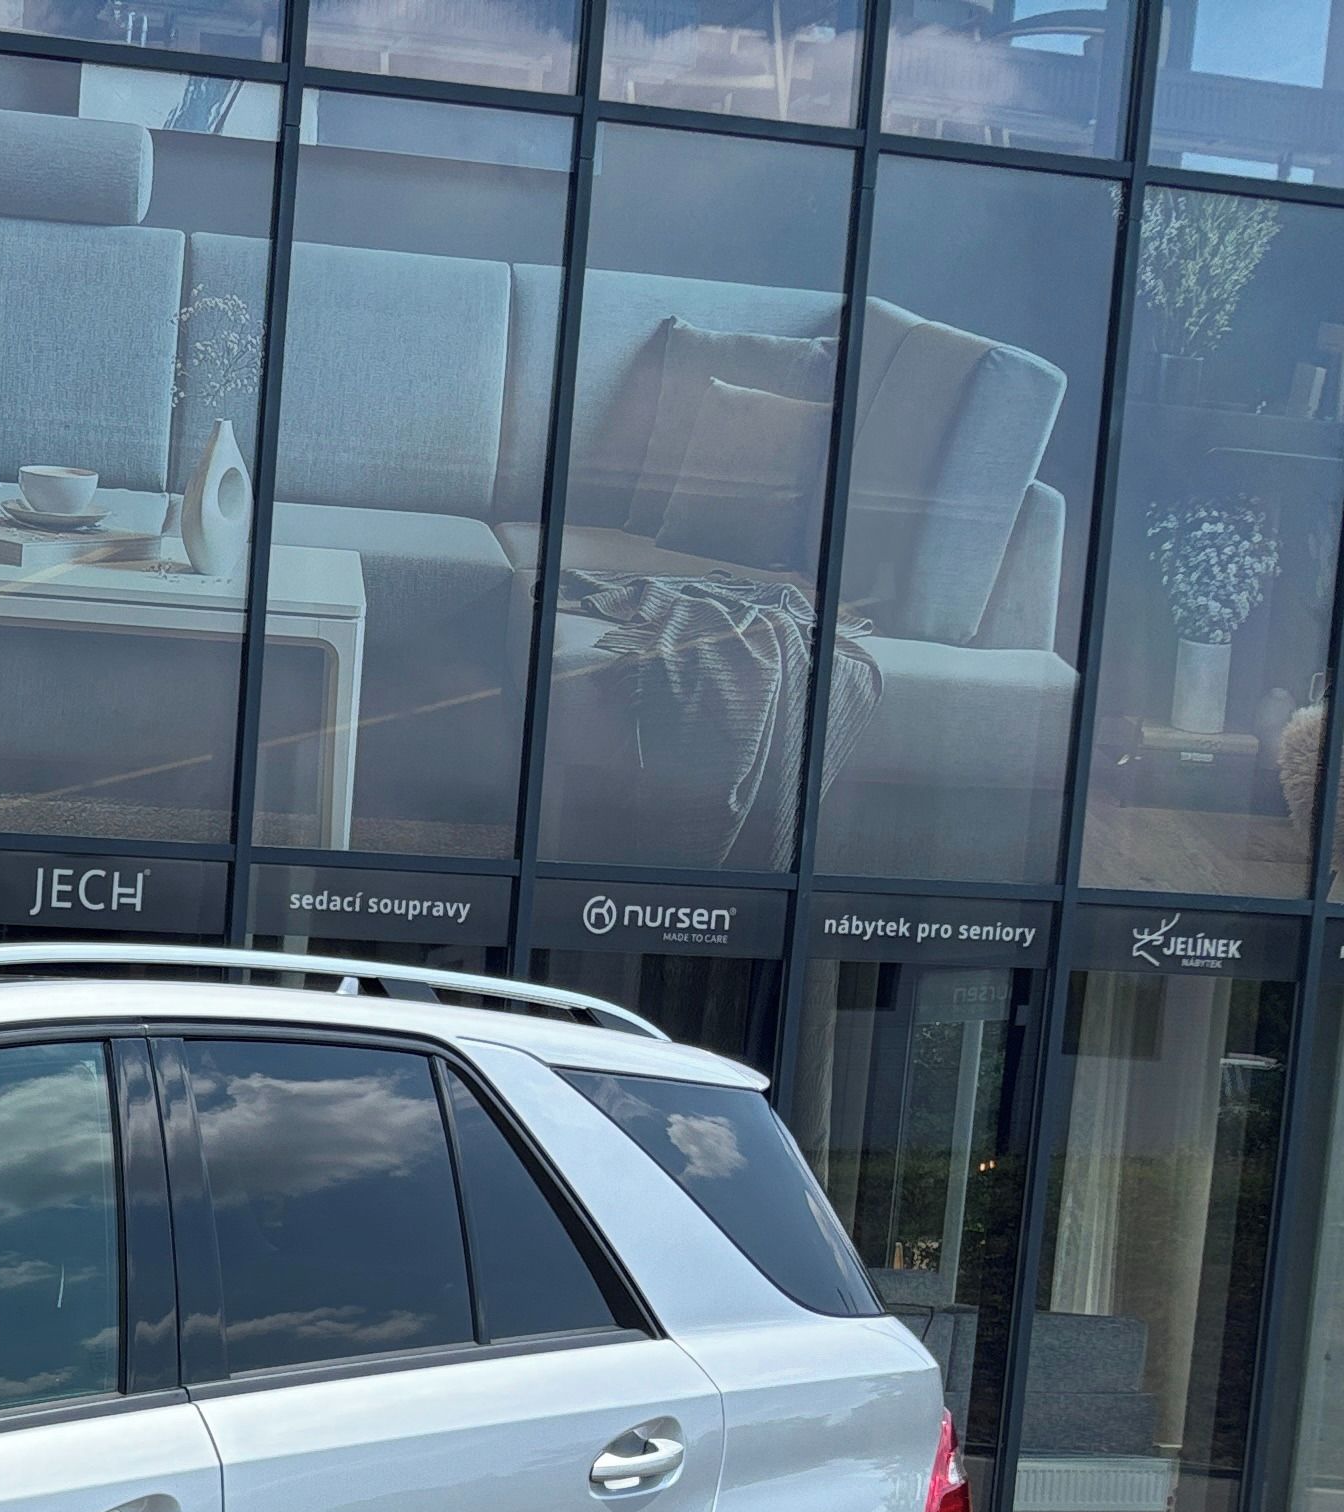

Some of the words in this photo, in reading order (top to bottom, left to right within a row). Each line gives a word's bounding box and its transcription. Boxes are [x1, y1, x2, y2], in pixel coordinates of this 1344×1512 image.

[289, 889, 361, 912] sedací
[367, 896, 471, 923] soupravy
[662, 932, 690, 943] MADE
[691, 933, 704, 943] TO
[704, 934, 729, 945] CARE
[823, 914, 911, 938] nábytek
[916, 921, 952, 941] pro
[958, 921, 1037, 947] seniory
[1162, 932, 1244, 959] JELÍNEK
[1181, 957, 1223, 969] NÁBYTEK
